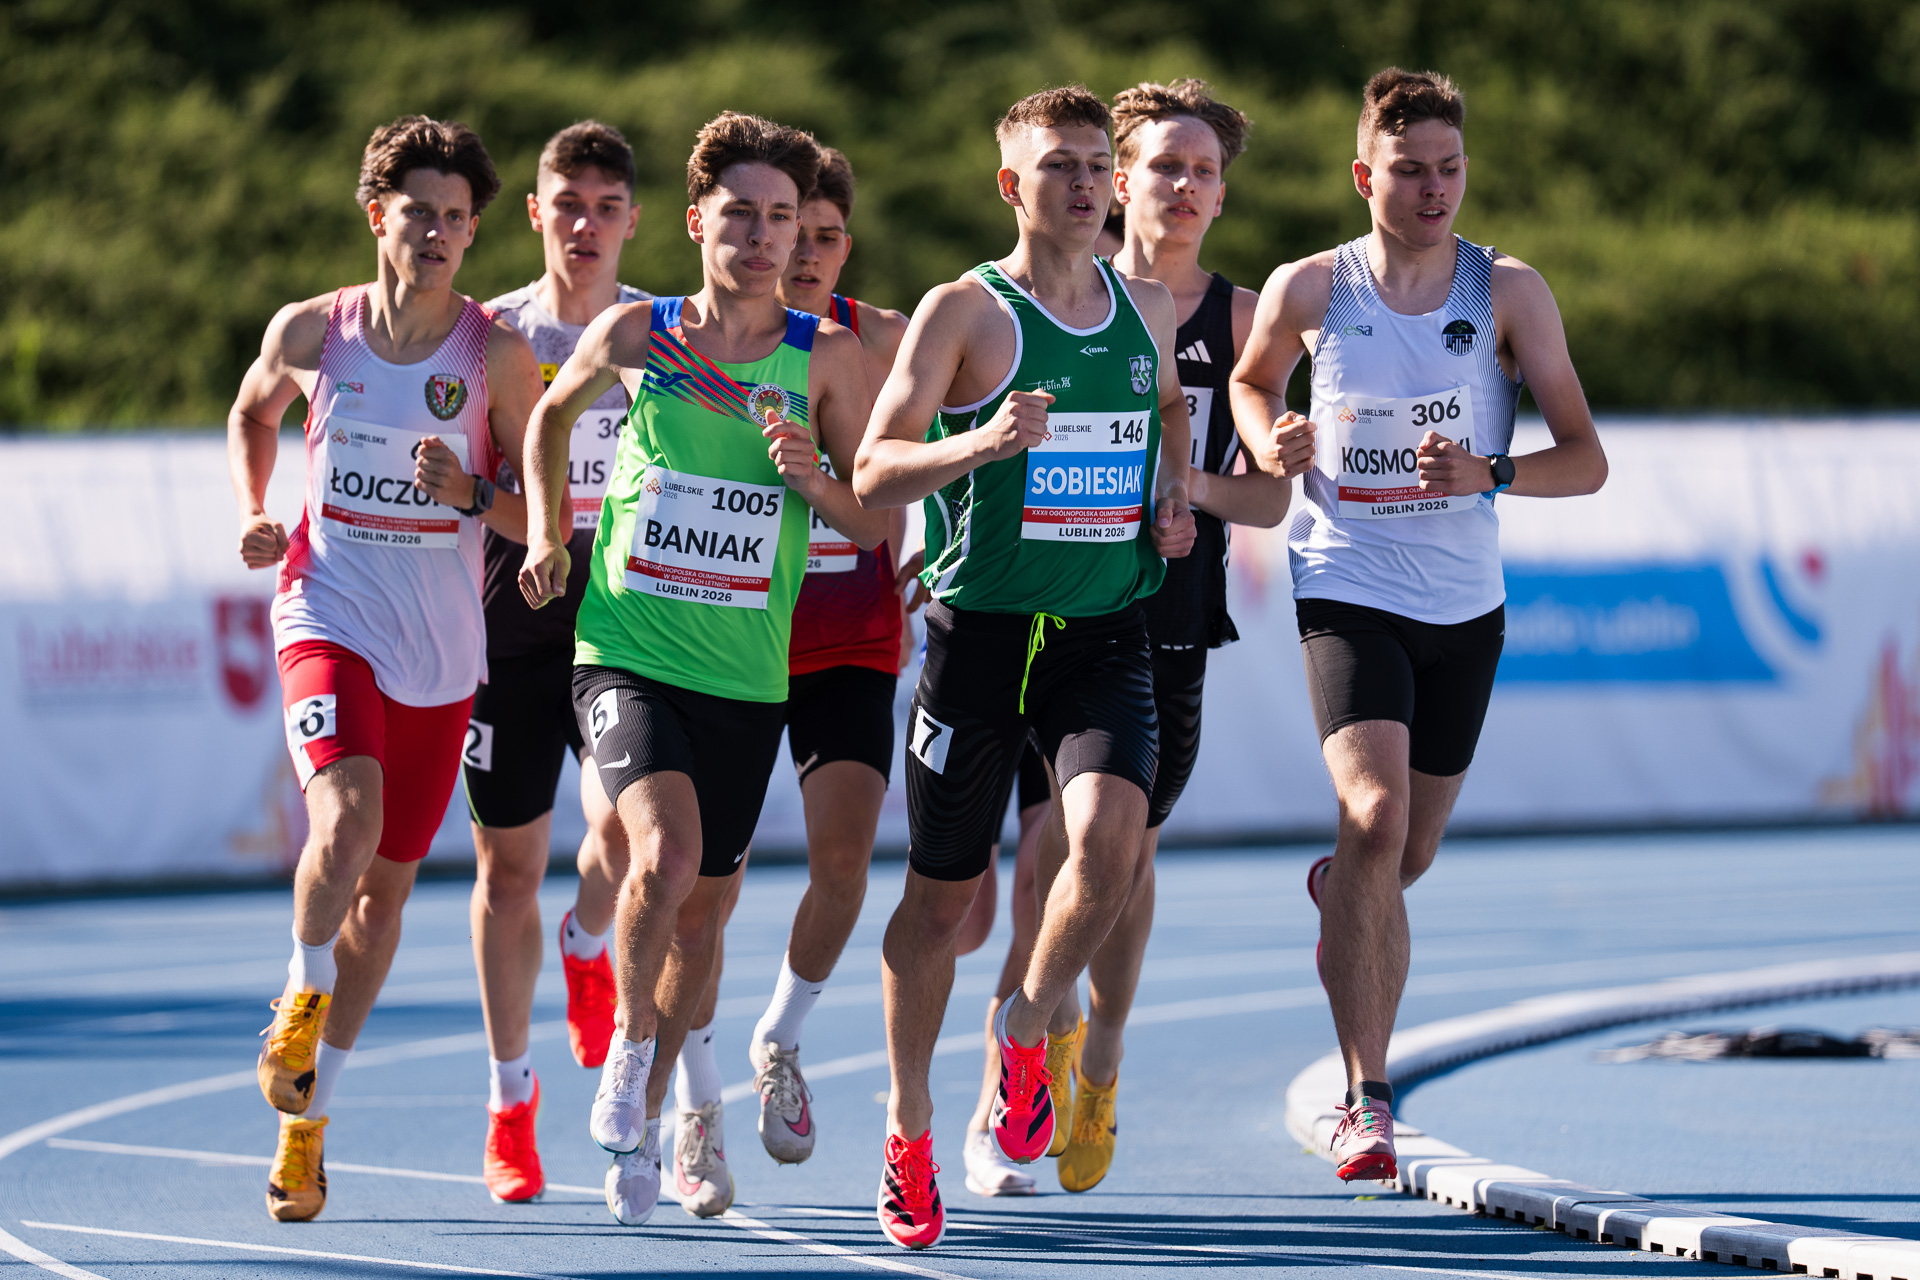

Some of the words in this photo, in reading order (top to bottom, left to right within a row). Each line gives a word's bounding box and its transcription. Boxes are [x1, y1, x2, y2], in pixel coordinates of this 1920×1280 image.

[1357, 408, 1395, 417] LUBELSKIE
[1411, 395, 1461, 427] 306
[1054, 425, 1092, 433] LUBELSKIE
[1109, 419, 1144, 444] 146
[350, 431, 387, 445] LUBELSKIE
[330, 467, 440, 507] ŁOJCZU
[664, 481, 704, 496] LUBELSKIE
[1030, 465, 1143, 495] SOBIESIAK
[663, 490, 678, 500] 2026
[1360, 487, 1408, 496] OGÓLNOPOLSKA
[1383, 494, 1417, 502] SPORTACH
[711, 486, 780, 517] 1005
[1371, 503, 1415, 516] LUBLIN
[1417, 500, 1449, 512] 2026
[1049, 509, 1098, 517] OGÓLNOPOLSKA
[347, 528, 389, 543] LUBLIN
[391, 534, 422, 545] 2026
[1059, 527, 1102, 537] LUBLIN
[1104, 527, 1126, 537] 2026
[644, 519, 764, 564] BANIAK
[807, 559, 821, 568] 26
[648, 562, 697, 578] OGÓLNOPOLSKA
[697, 572, 731, 583] OLIMPIADA
[731, 576, 763, 585] MŁODZIEŻY
[671, 574, 705, 586] SPORTACH
[704, 580, 731, 589] LETNICH
[655, 582, 699, 598] LUBLIN
[701, 589, 732, 602] 2026
[299, 699, 325, 738] 6
[592, 702, 609, 739] 5
[465, 723, 483, 764] 2
[920, 715, 943, 759] 7
